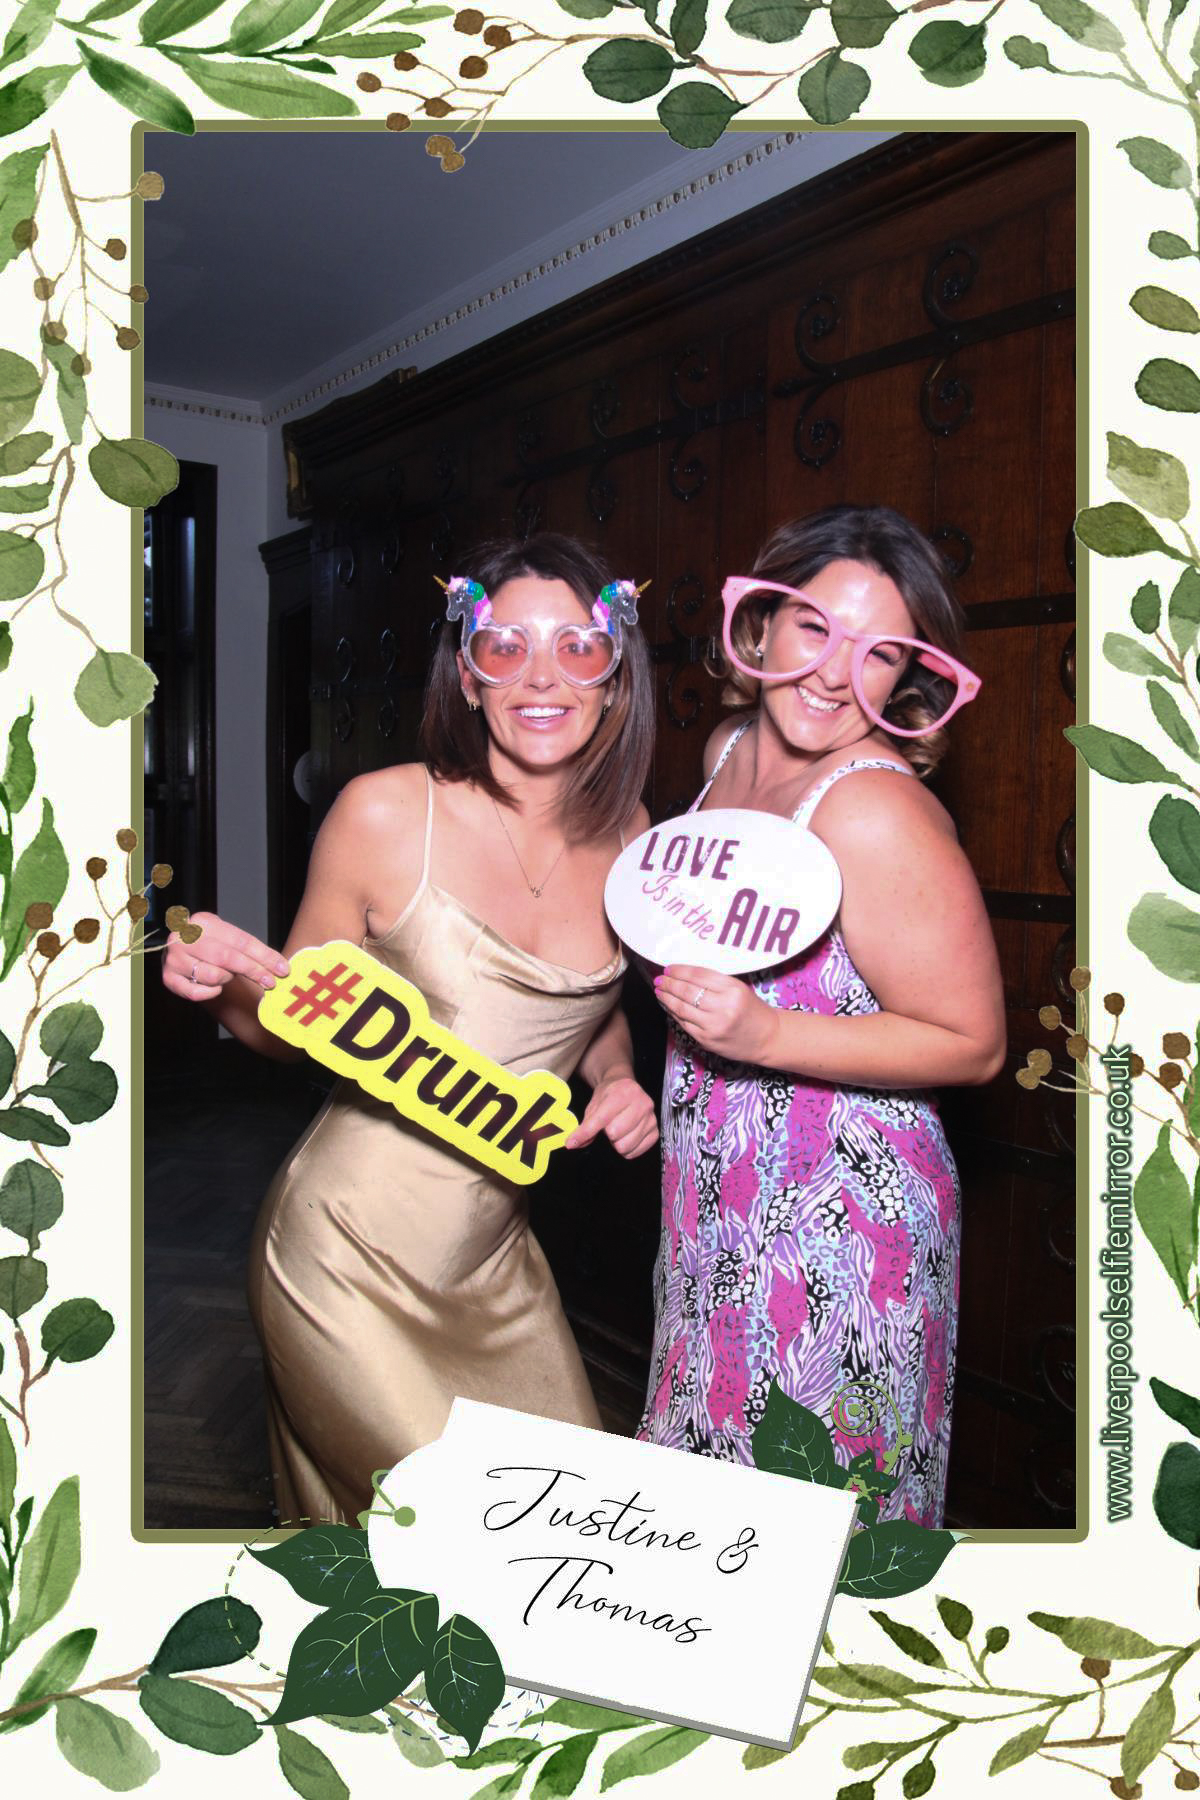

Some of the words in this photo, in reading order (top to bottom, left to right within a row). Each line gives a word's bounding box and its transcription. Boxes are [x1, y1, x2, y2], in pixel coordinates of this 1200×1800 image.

[639, 831, 740, 881] LOVE
[642, 874, 679, 902] Is
[667, 896, 687, 916] in
[681, 903, 715, 940] the
[717, 888, 801, 955] AIR
[283, 962, 565, 1170] #Drunk
